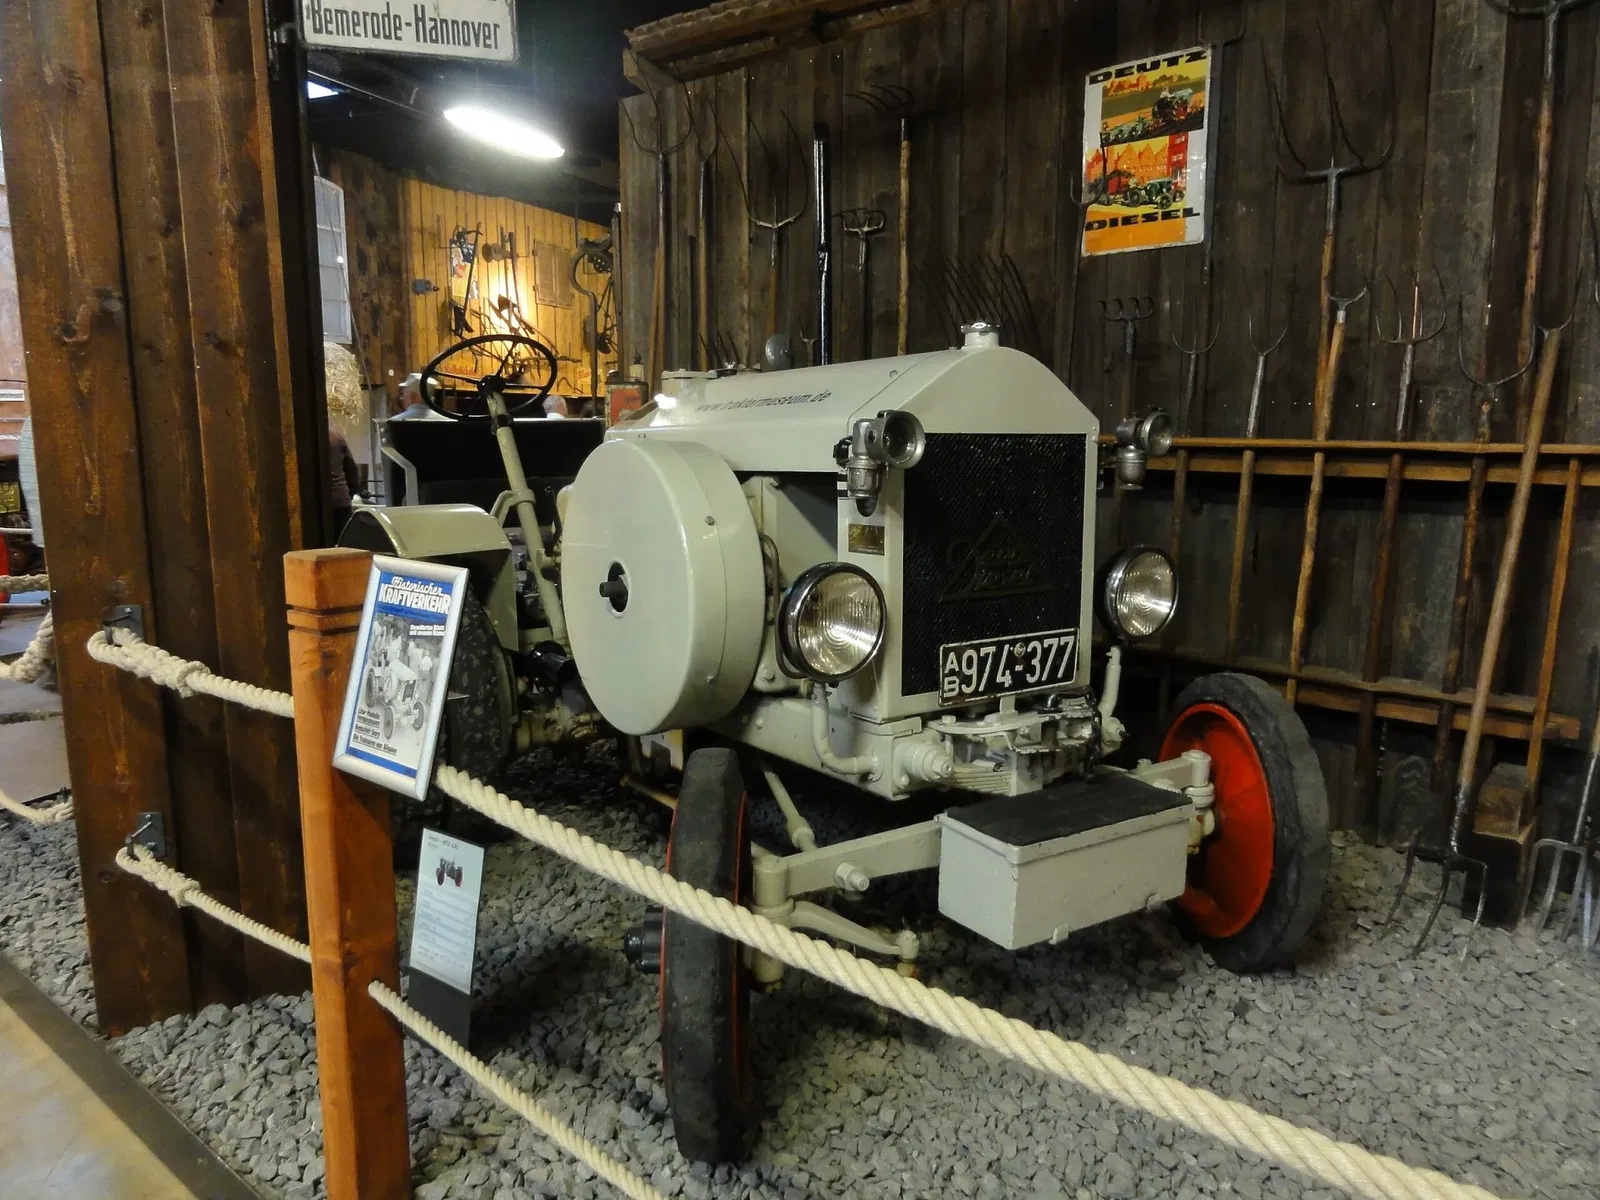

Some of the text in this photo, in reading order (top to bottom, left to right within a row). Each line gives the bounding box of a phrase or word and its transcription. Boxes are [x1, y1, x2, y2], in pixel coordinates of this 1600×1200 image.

[311, 0, 500, 50] Bemerode-Hannover
[1088, 49, 1208, 85] DEUTZ
[1085, 207, 1201, 232] DIESEL
[379, 583, 452, 614] KRAFTVERKEHR
[391, 576, 444, 596] Historischer
